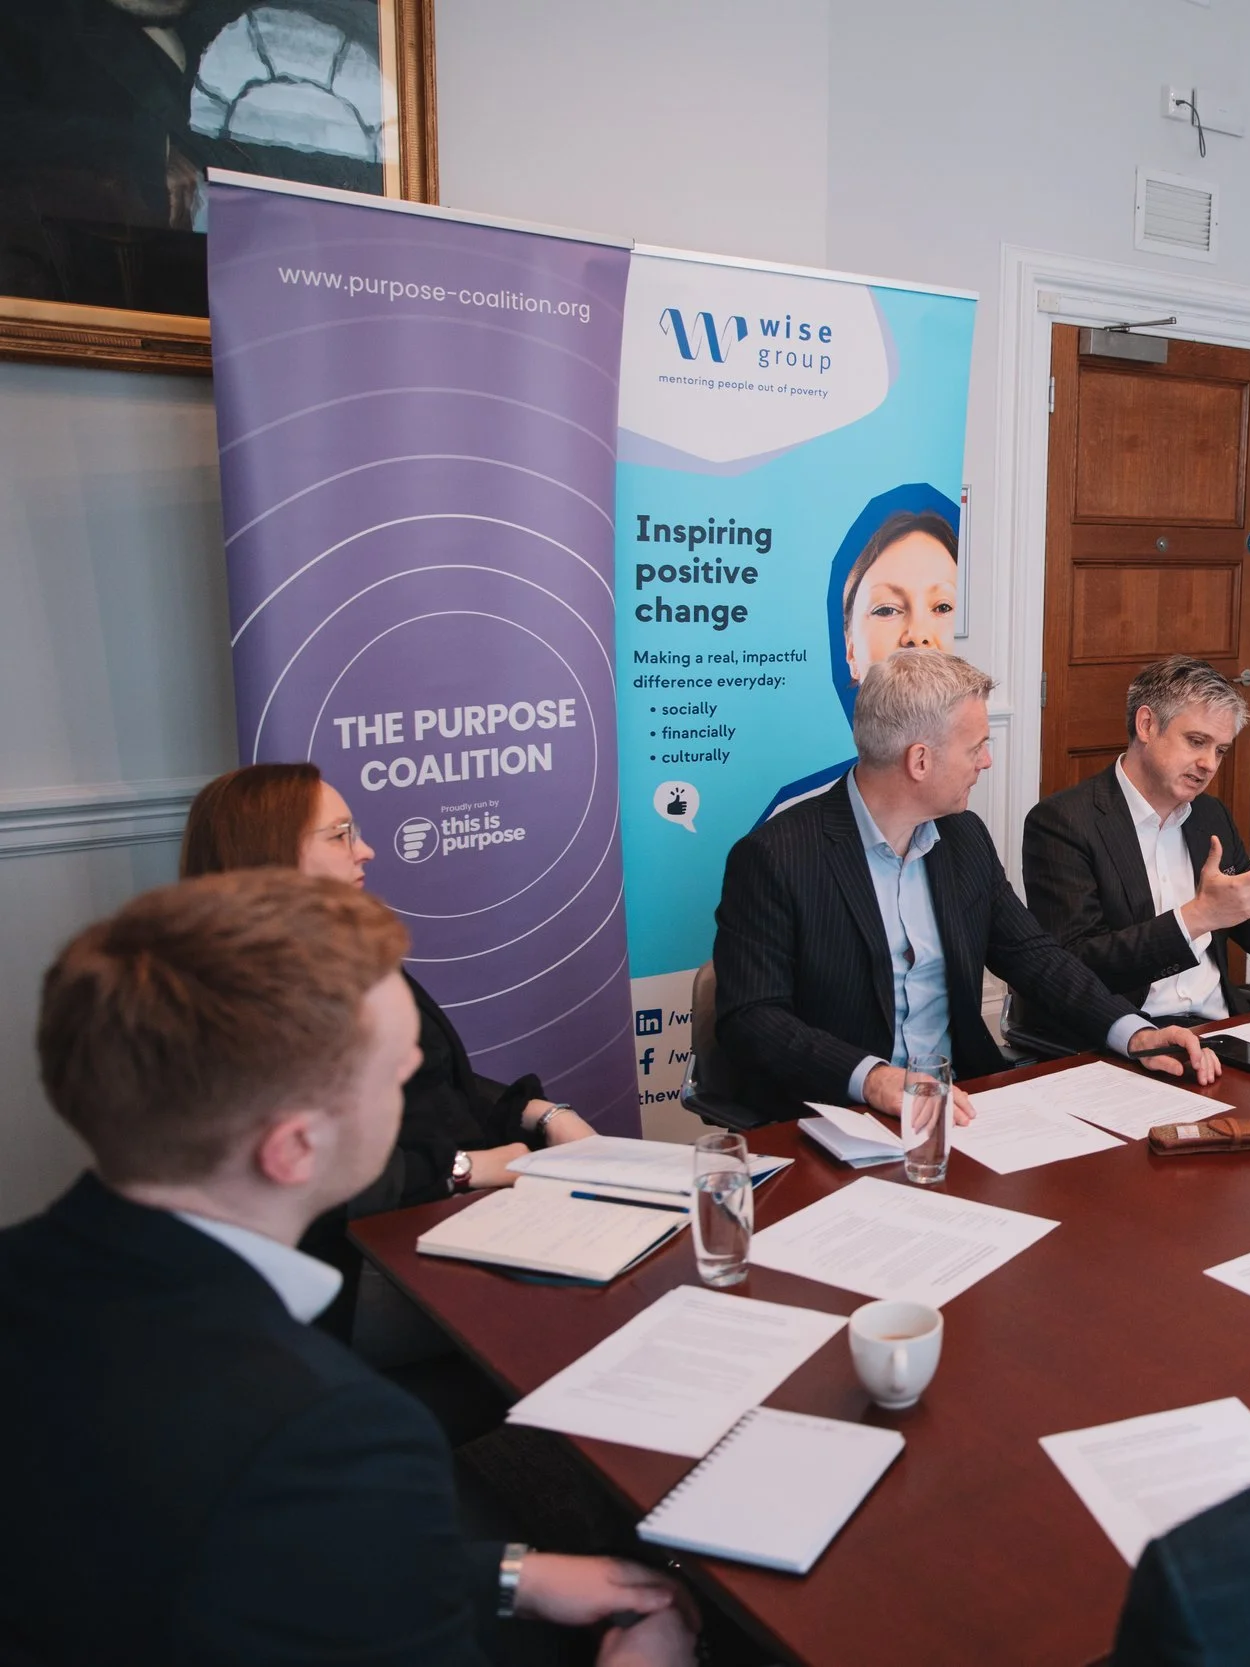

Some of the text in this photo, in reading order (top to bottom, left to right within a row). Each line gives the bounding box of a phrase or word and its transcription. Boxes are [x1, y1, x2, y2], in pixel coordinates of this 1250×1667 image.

[278, 267, 590, 323] www.purpose-coalition.org
[760, 315, 832, 343] wise
[758, 349, 831, 374] group
[659, 375, 828, 399] mentoring people out of poverty
[637, 515, 772, 554] Inspiring
[636, 557, 758, 590] positive
[635, 596, 748, 631] change
[633, 650, 807, 668] Making a real, impactful
[633, 674, 785, 690] difference everyday:
[662, 702, 717, 718] socially
[333, 698, 576, 749] THE PURPOSE
[662, 725, 736, 740] financially
[360, 743, 552, 791] COALITION
[662, 748, 730, 764] culturally
[441, 803, 472, 813] Proudly
[489, 799, 499, 808] by
[441, 811, 500, 836] this is
[442, 827, 525, 856] purpose
[639, 1084, 683, 1105] thew
